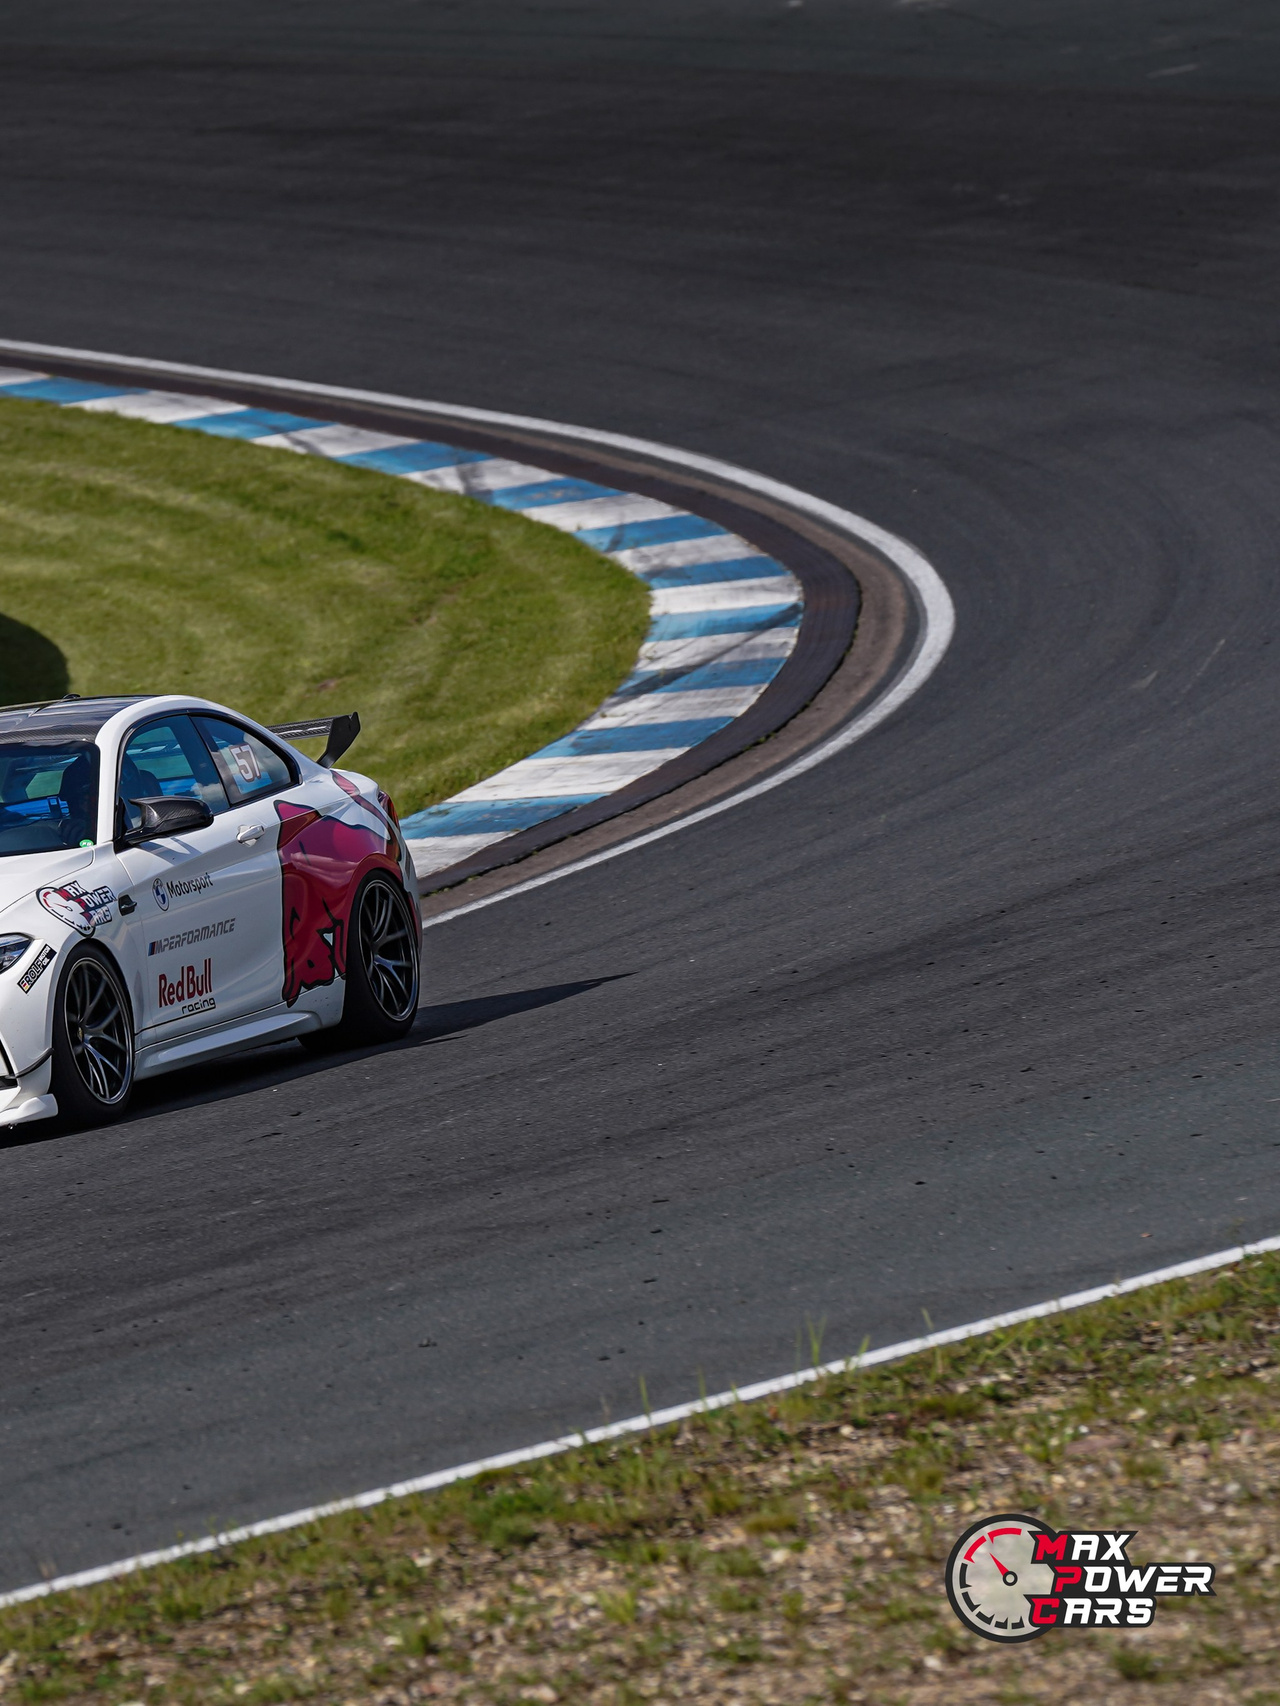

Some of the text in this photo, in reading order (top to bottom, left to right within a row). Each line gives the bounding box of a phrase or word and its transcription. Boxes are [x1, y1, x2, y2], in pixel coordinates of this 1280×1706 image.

[229, 744, 261, 780] 57
[55, 881, 86, 902] MAX
[166, 872, 213, 898] Motorsport
[75, 886, 117, 911] POWER
[23, 959, 44, 986] ROLF
[158, 958, 212, 1008] Red Bull
[181, 997, 216, 1014] racing
